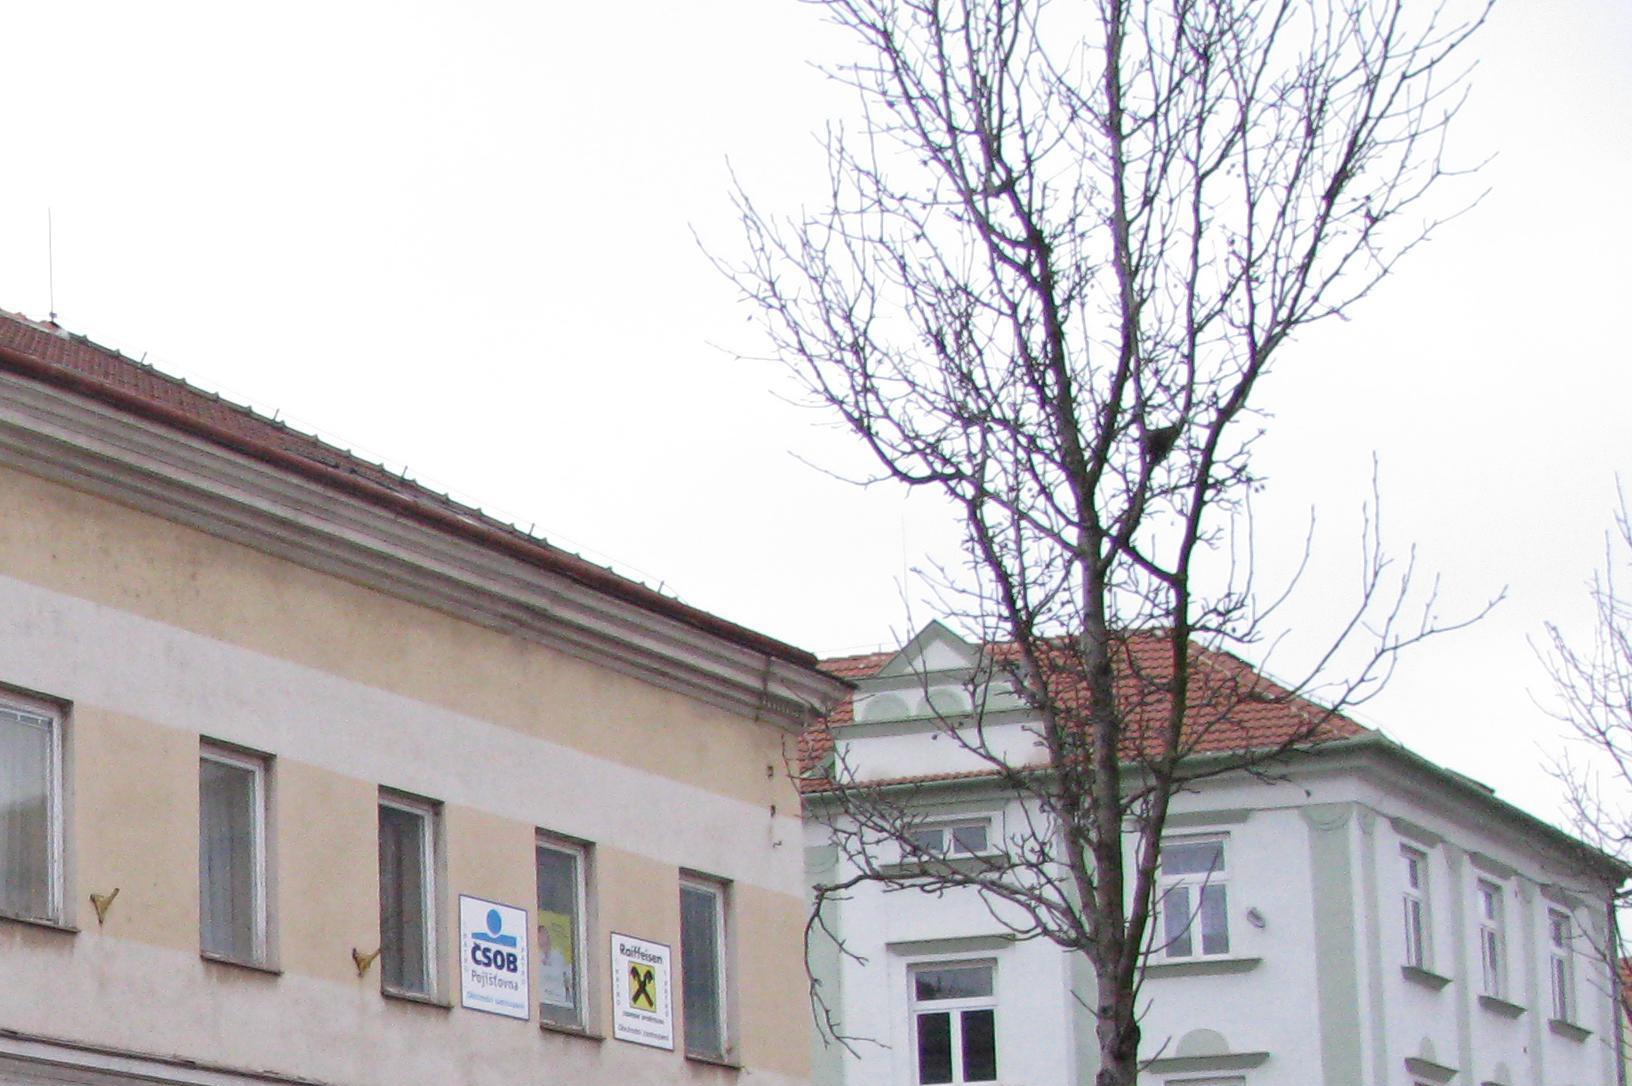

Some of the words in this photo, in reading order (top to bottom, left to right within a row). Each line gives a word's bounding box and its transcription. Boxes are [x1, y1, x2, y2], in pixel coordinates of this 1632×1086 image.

[471, 941, 518, 973] ČSOB
[619, 943, 663, 964] Raiffeisen
[471, 970, 518, 991] Pojišťovna
